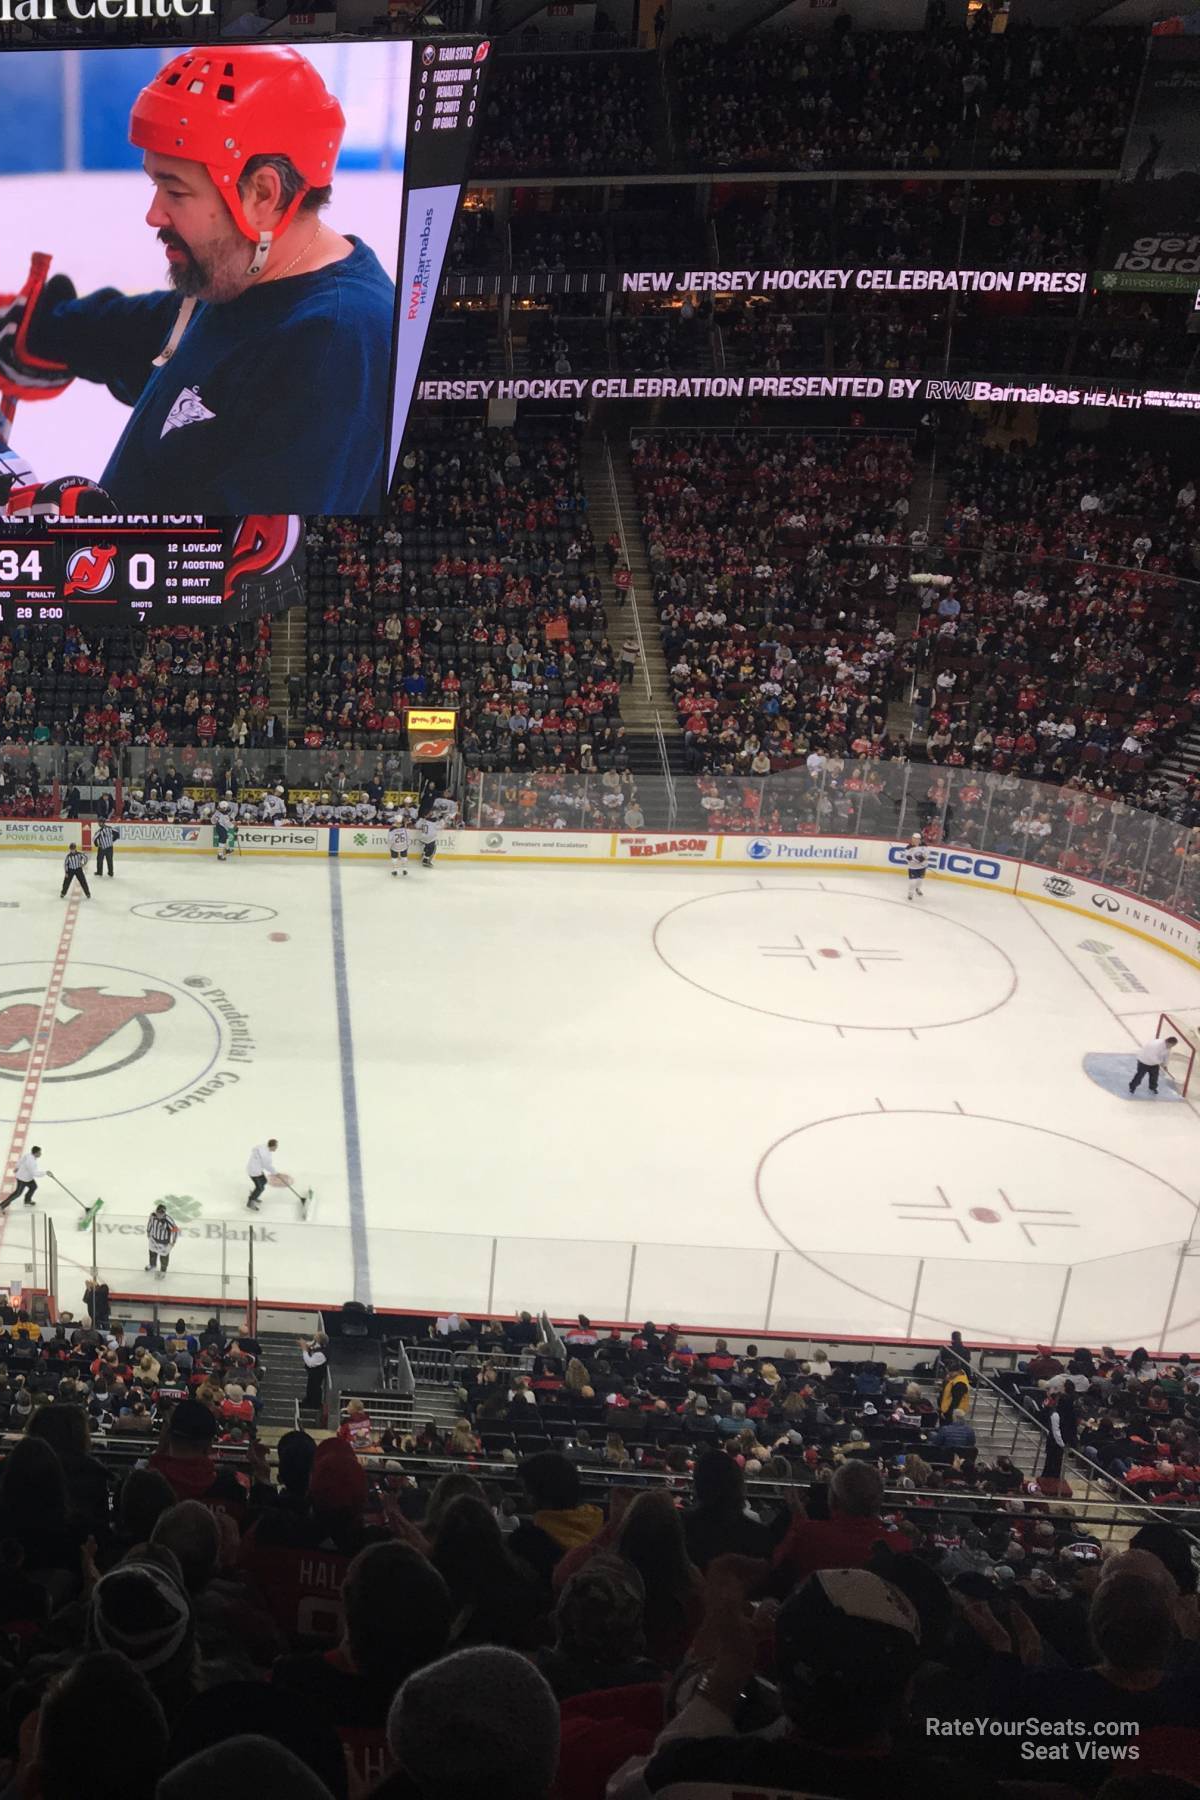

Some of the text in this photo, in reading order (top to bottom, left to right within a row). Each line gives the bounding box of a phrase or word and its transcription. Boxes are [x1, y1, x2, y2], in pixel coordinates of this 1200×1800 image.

[421, 70, 428, 83] 8
[475, 67, 481, 80] 1
[419, 88, 426, 101] 0
[472, 84, 478, 97] 1
[416, 103, 423, 117] 0
[469, 99, 476, 112] 0
[414, 119, 421, 132] 0
[467, 115, 473, 128] 0
[622, 270, 1016, 293] NEW JERSEY HOCKEY CELEBRATION
[498, 379, 590, 400] HOCKEY
[591, 377, 747, 399] CELEBRATION
[748, 377, 884, 399] PRESENTED
[887, 378, 922, 399] BY
[167, 544, 223, 553] 12 LOVEJOY
[129, 553, 155, 590] 0
[168, 561, 224, 570] 17 AGOSTINO
[165, 578, 210, 587] 63 BRATT
[26, 591, 56, 599] PENALTY
[167, 595, 222, 605] 13 HISCHIER
[16, 607, 63, 619] 28 2:00
[138, 612, 146, 622] 7
[5, 824, 64, 833] EAST COAST
[120, 825, 184, 841] HALMAR
[5, 834, 38, 842] POWER
[511, 840, 542, 848] Elevators
[777, 843, 858, 860] Prudential
[1043, 876, 1076, 894] NHL
[153, 901, 252, 922] Ford
[1126, 906, 1189, 944] INFINITI
[161, 985, 257, 1117] Prudential Center
